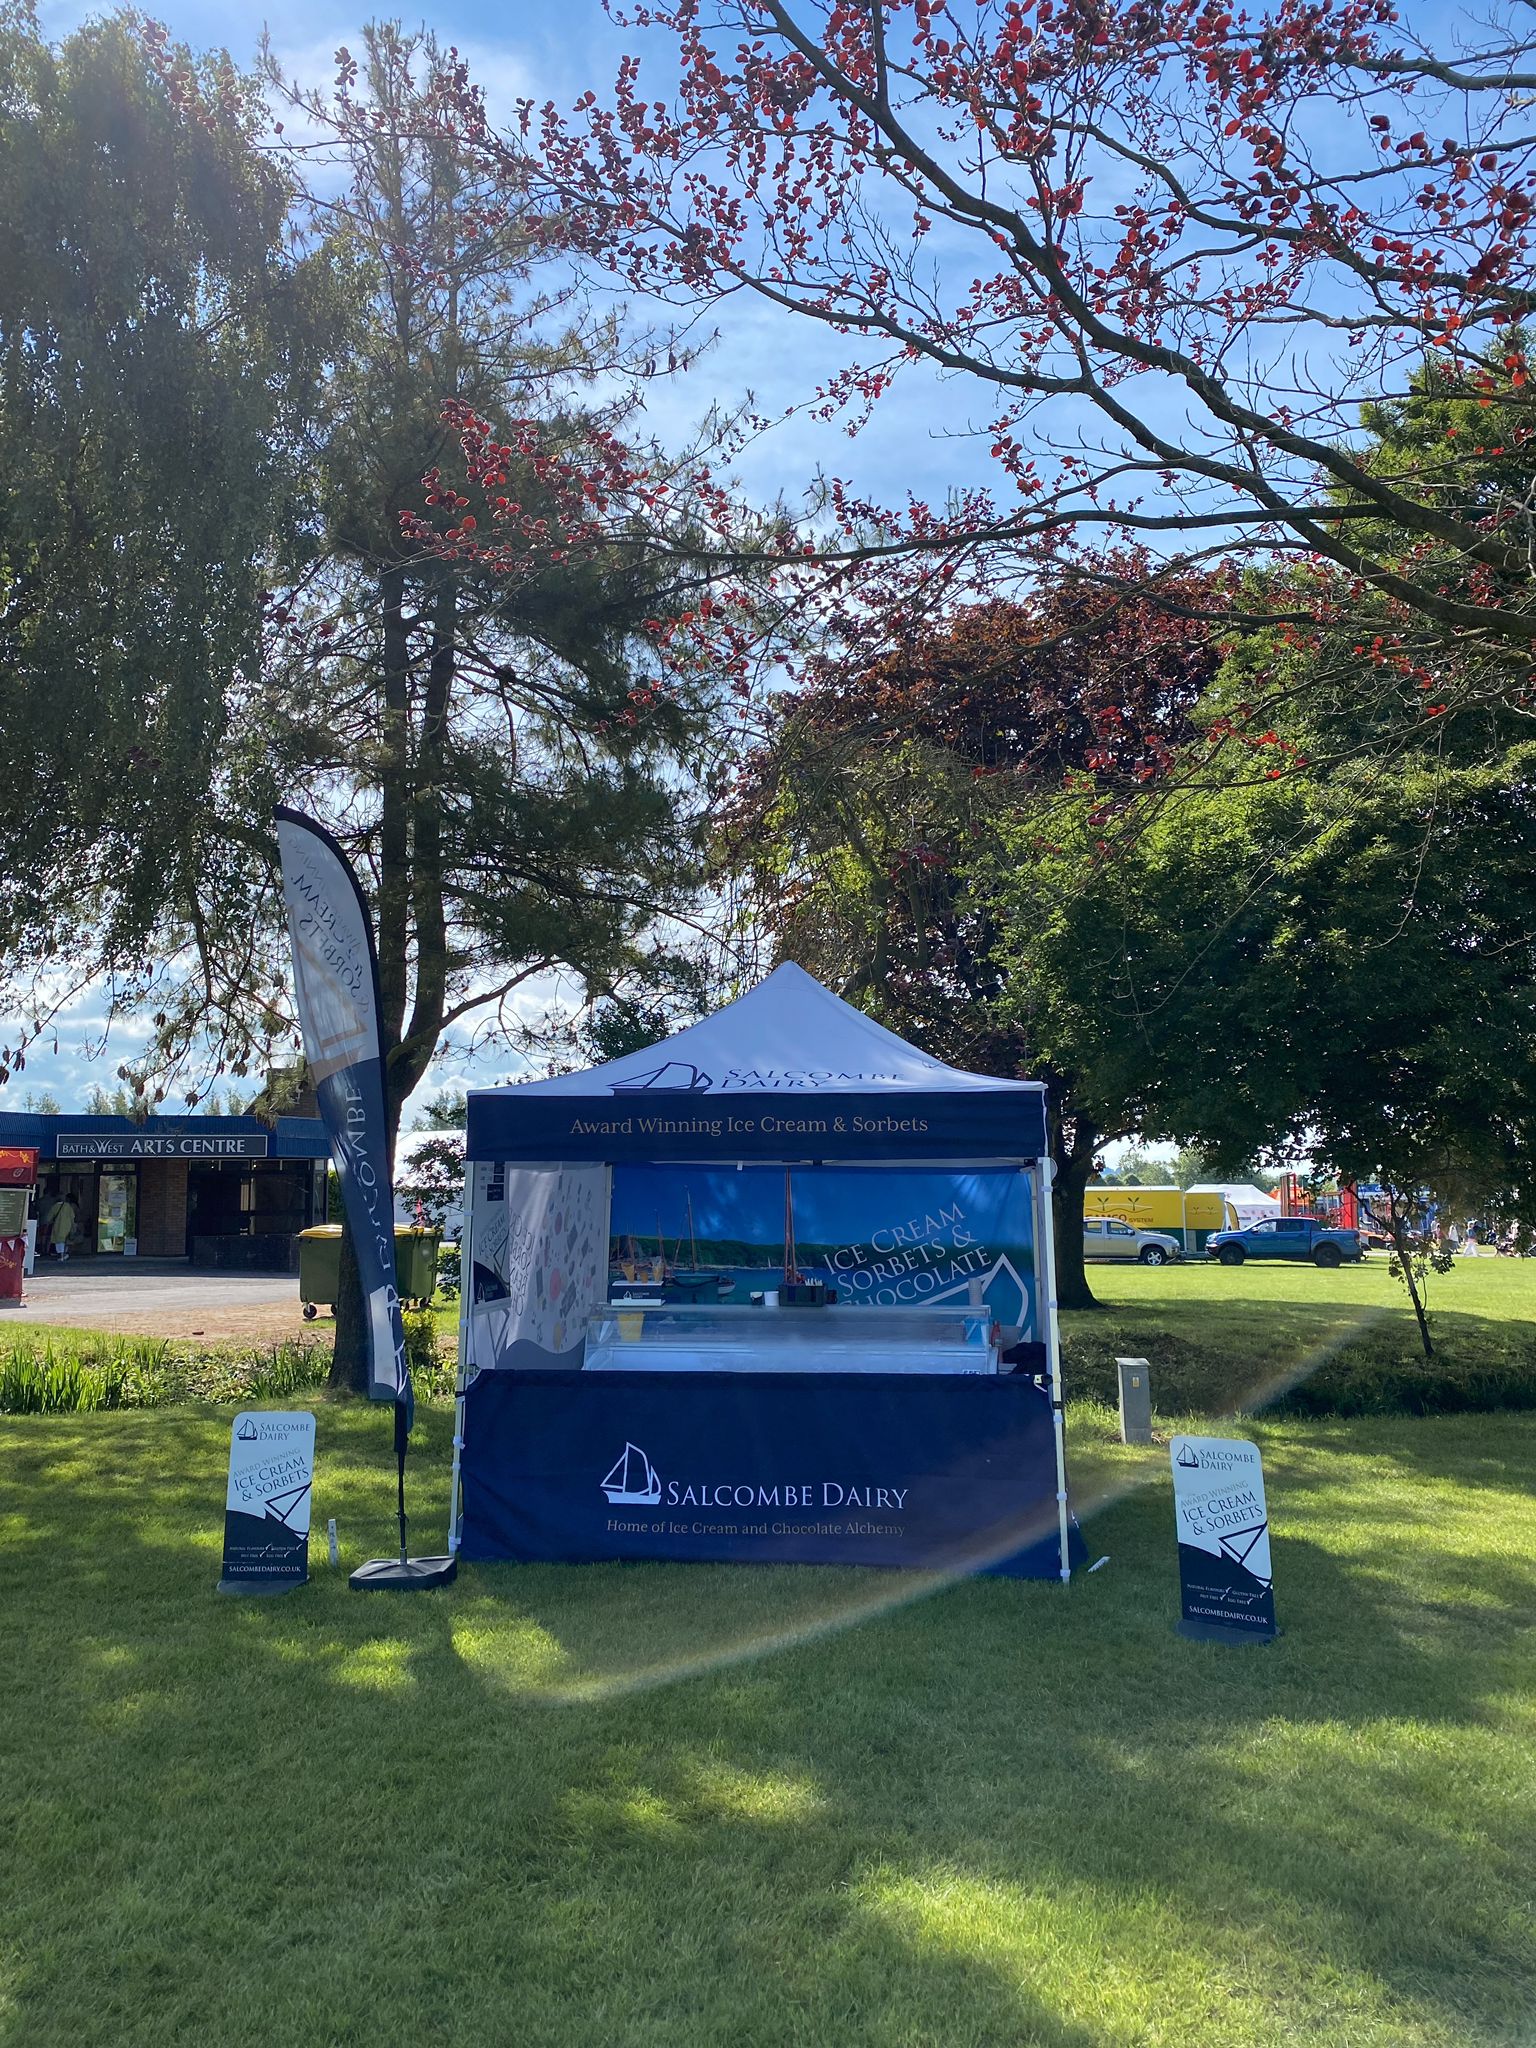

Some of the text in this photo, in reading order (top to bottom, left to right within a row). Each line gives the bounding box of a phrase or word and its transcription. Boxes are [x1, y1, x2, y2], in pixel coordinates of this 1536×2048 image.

[721, 1079, 830, 1089] DAIRY
[724, 1068, 905, 1081] SALCOMBE
[570, 1116, 929, 1136] Award Winning Ice Cream & Sorbets
[130, 1139, 175, 1153] ARTS
[179, 1139, 246, 1153] CENTRE
[822, 1201, 967, 1276] ICE CREAM
[837, 1224, 980, 1298] SORBETS &
[838, 1245, 992, 1305] OCOLATE
[259, 1423, 310, 1432] SALCOMBE
[259, 1431, 290, 1441] DAIRY
[233, 1448, 301, 1478] AWARD WINNING
[1200, 1449, 1255, 1464] SALCOMBE
[1201, 1459, 1234, 1471] DAIRY
[234, 1456, 305, 1492] ICE CREAM
[241, 1467, 310, 1502] & SORBETS
[667, 1481, 909, 1509] SALCOMBE DAIRY
[1180, 1480, 1249, 1508] AWARD WINNING
[1183, 1491, 1256, 1523] ICE CREAM
[607, 1519, 905, 1537] Home of Ice Cream and Chocolate Alchemy
[1193, 1504, 1263, 1536] & SORBETS
[1189, 1605, 1269, 1624] SALCOMBEDAIRY.CO.UK
